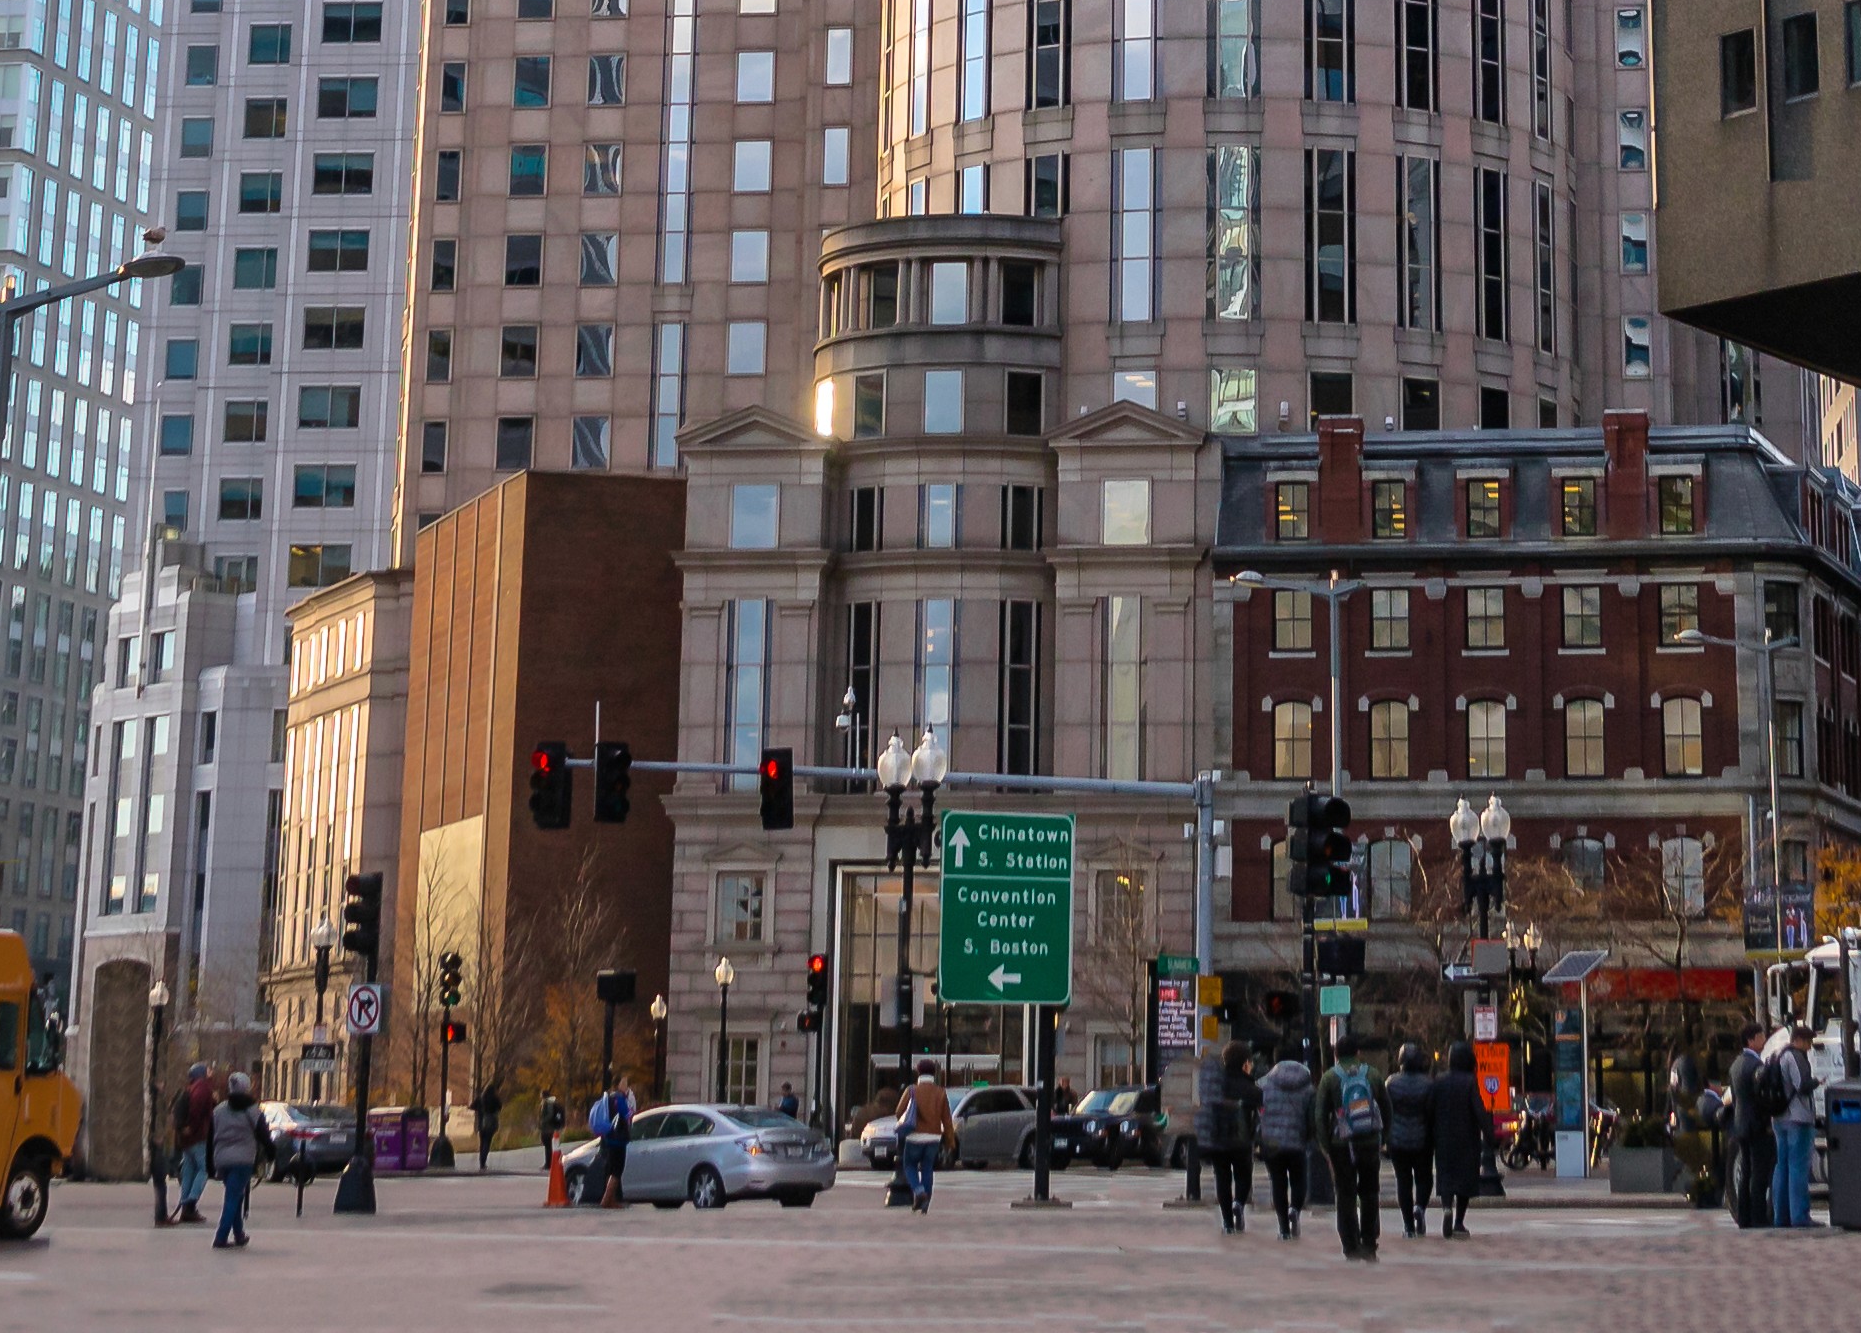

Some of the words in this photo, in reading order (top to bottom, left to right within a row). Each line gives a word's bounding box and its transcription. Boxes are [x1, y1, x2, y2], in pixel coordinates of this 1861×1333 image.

[978, 823, 1069, 843] Chinatown
[978, 851, 994, 868] S.
[1006, 852, 1068, 870] Station
[957, 886, 1056, 905] Convention
[977, 910, 1036, 929] Center
[964, 937, 980, 955] S.
[990, 938, 1049, 957] Boston
[1485, 1078, 1498, 1091] 90
